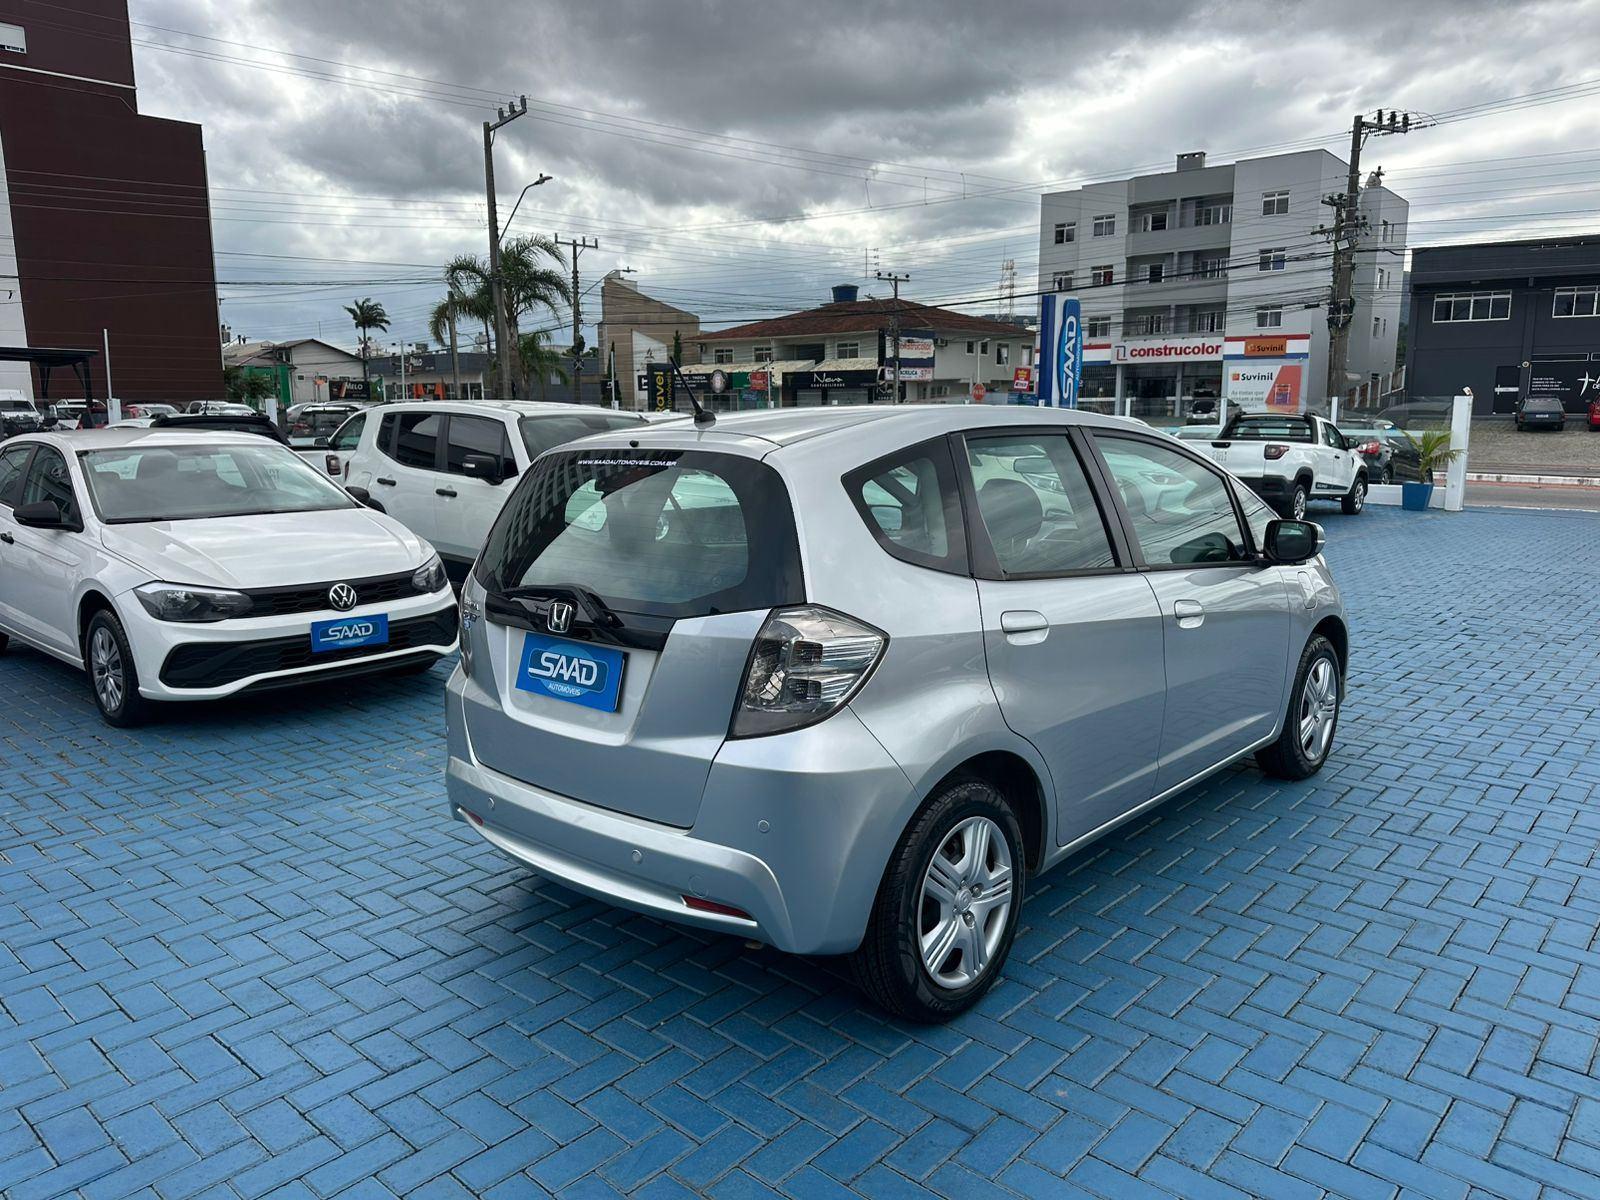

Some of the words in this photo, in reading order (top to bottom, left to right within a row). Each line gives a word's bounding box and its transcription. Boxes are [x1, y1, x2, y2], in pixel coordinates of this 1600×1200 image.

[1130, 343, 1222, 358] construcolor
[1256, 344, 1284, 352] Suvinil
[1063, 316, 1077, 408] SAAD
[1241, 372, 1273, 381] Suvinil
[320, 622, 373, 642] SAAD
[528, 651, 598, 686] SAAD
